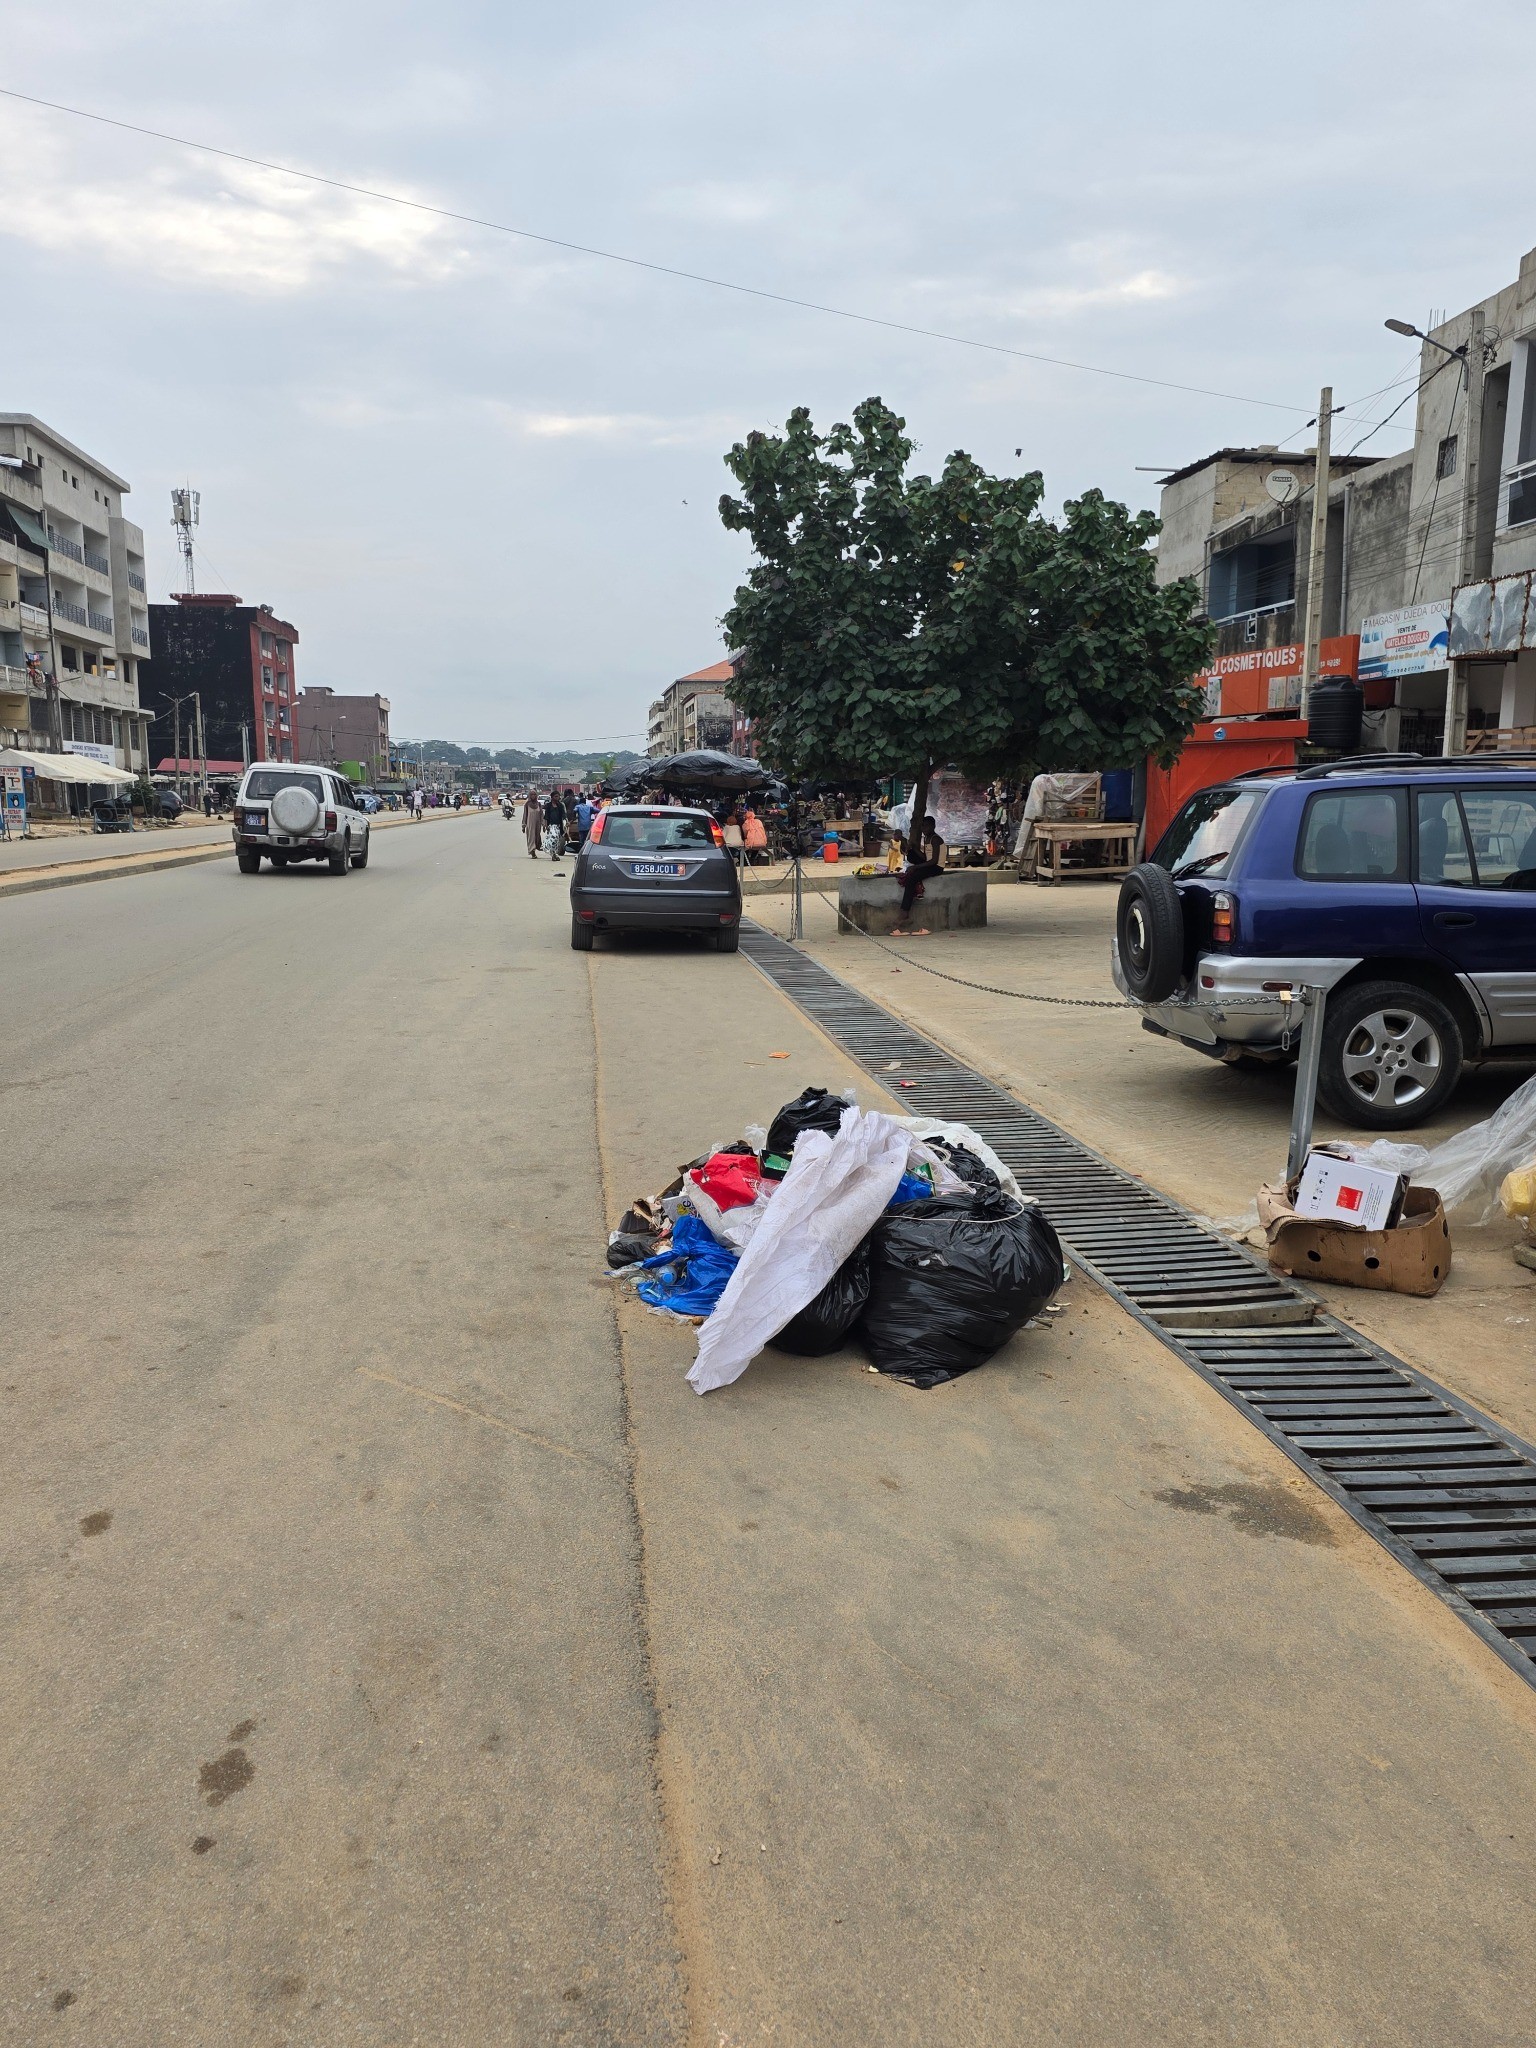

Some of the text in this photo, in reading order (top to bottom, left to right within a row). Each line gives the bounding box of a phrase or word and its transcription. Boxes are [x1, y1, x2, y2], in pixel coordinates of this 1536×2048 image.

[1368, 612, 1400, 628] MAGASIN
[1404, 606, 1427, 620] DJEDA
[1397, 626, 1411, 634] VENTE
[1386, 631, 1429, 648] MATELAS DOUGLAS
[1220, 647, 1297, 675] COSMETIQUES
[634, 864, 674, 874] 8258JC01
